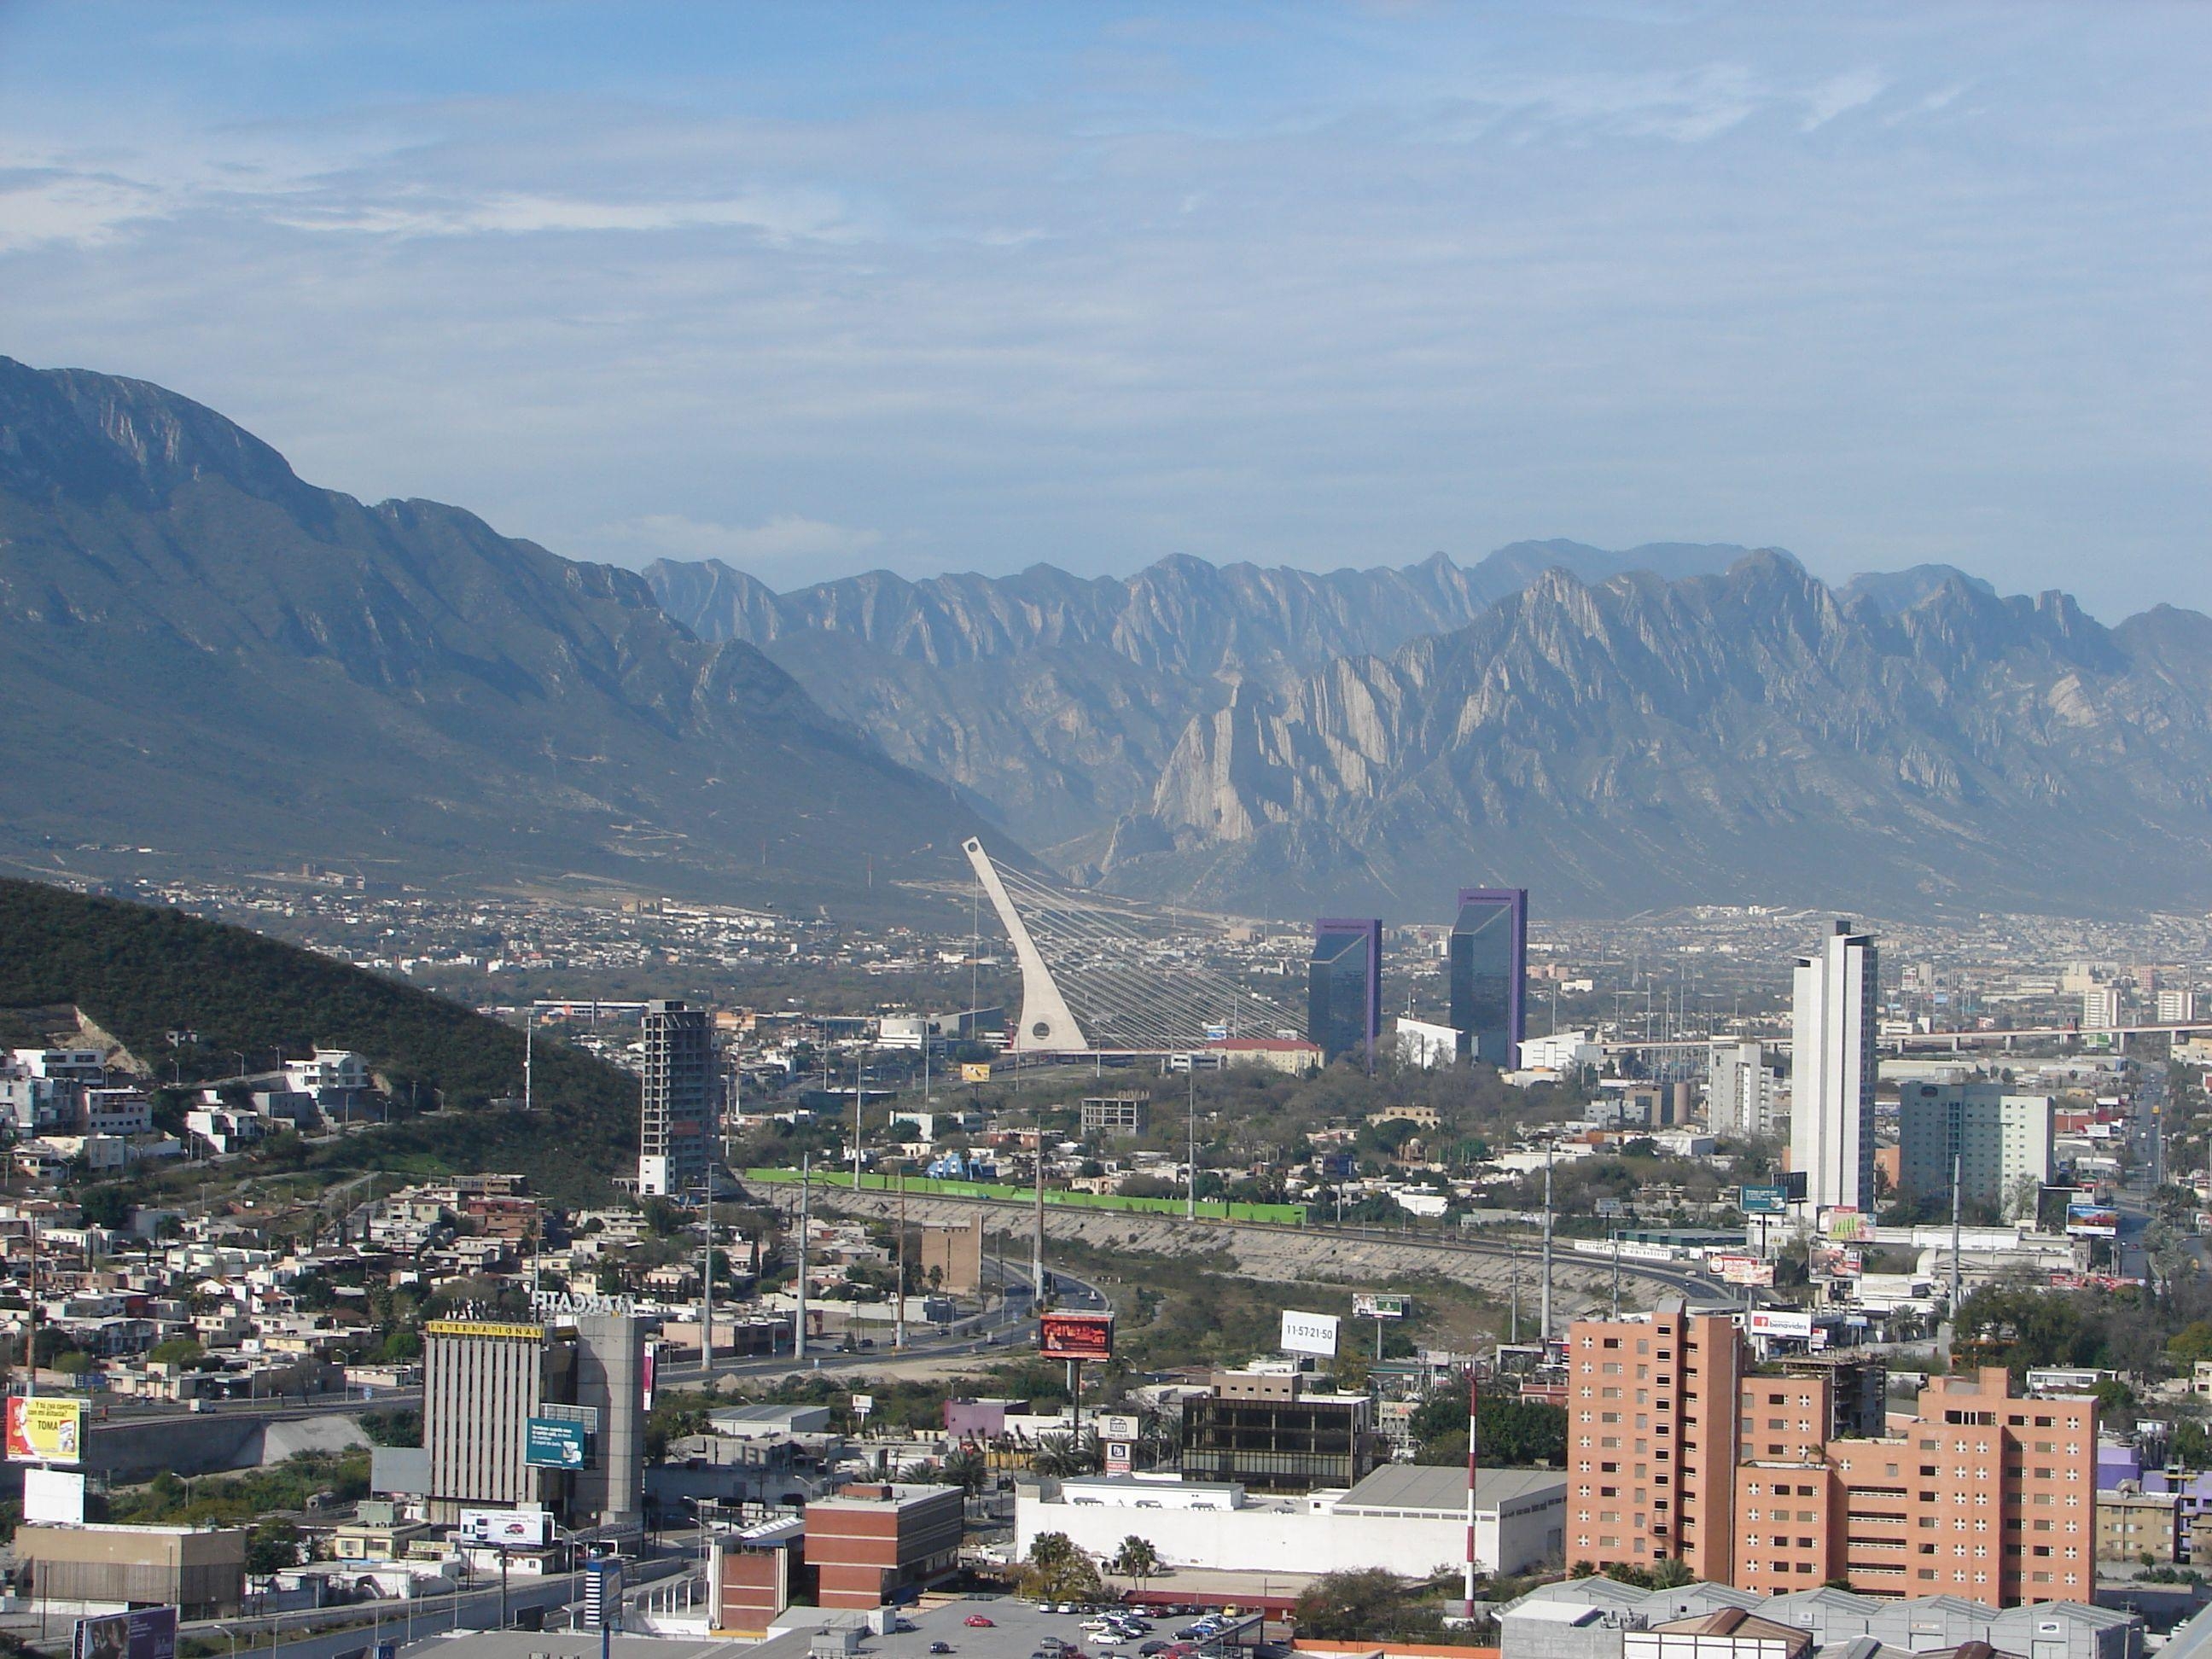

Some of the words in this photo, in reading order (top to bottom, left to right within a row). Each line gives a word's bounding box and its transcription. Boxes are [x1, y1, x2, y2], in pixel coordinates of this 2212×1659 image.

[430, 1323, 540, 1336] INTERNATIONAL
[1769, 1320, 1807, 1330] benavides
[38, 1420, 59, 1430] TOMA
